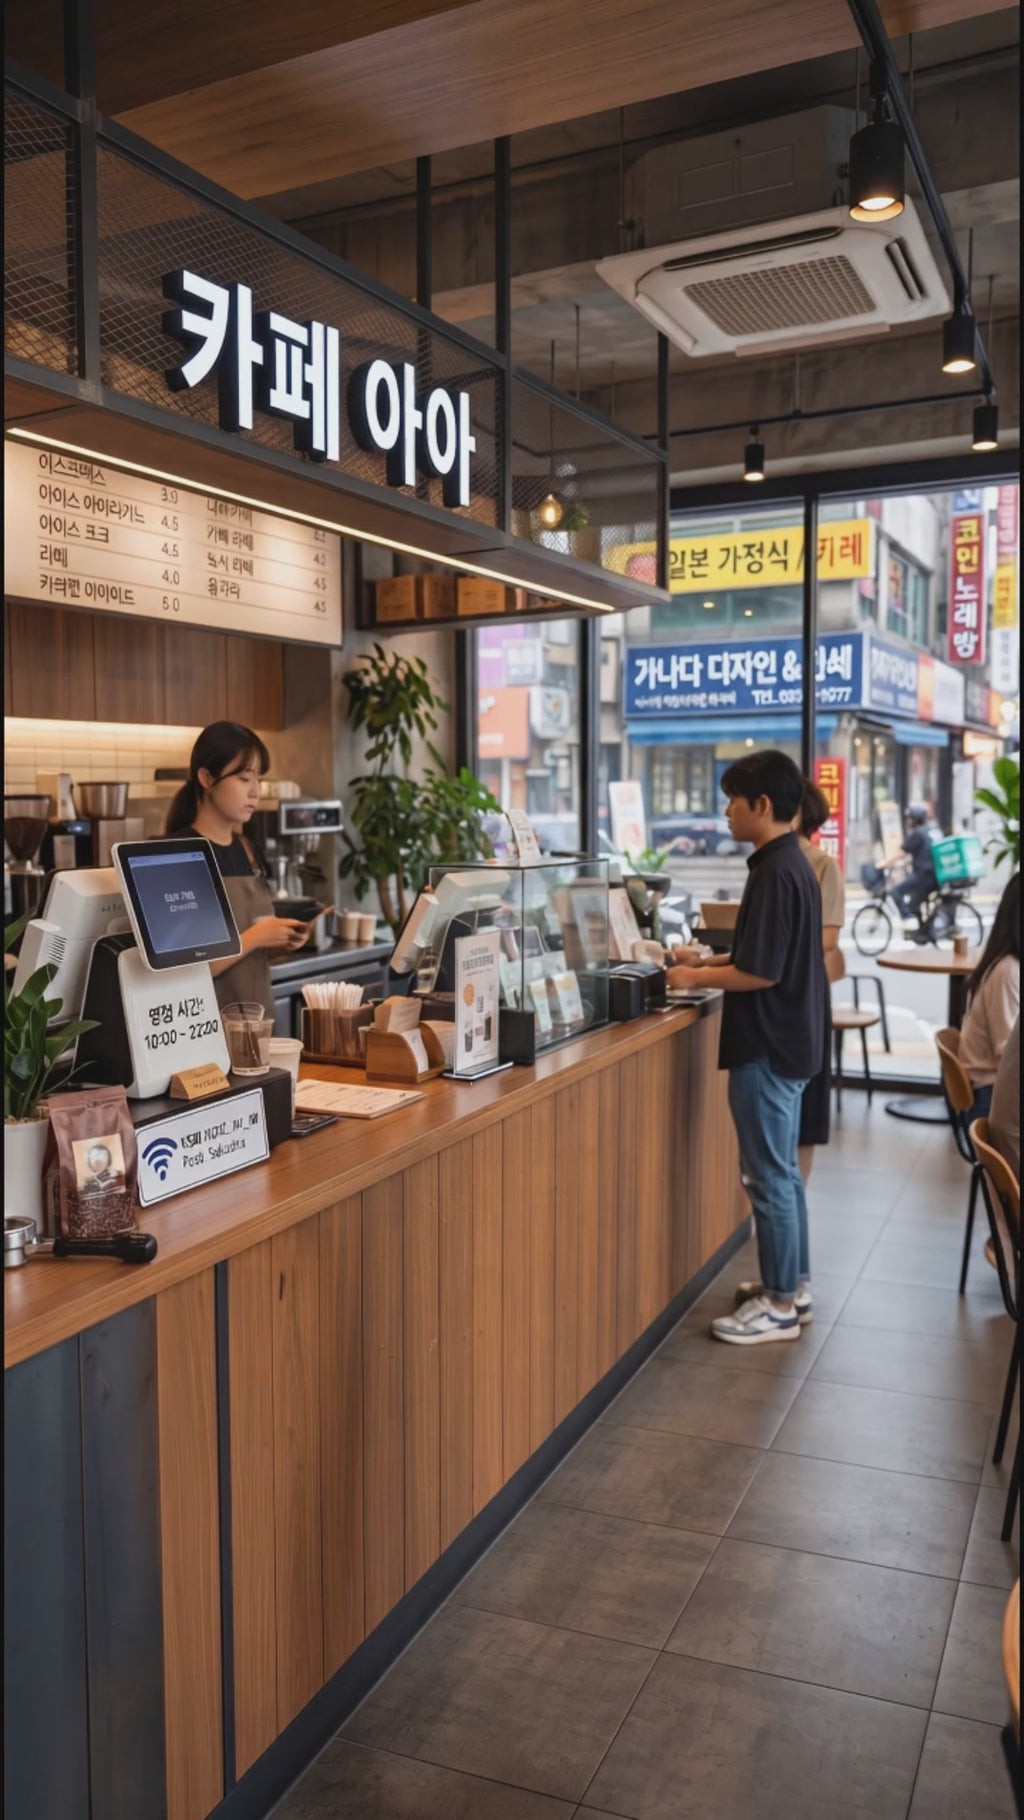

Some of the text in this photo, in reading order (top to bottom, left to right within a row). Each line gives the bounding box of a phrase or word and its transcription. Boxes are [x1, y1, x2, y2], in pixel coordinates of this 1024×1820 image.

[181, 269, 476, 507] 카페 아아
[161, 515, 179, 531] 4.5
[161, 542, 179, 557] 4.5
[718, 539, 789, 575] 가정식
[162, 569, 180, 585] 4.0
[634, 653, 704, 690] 가나다
[707, 649, 777, 686] 디자인
[782, 648, 803, 682] &
[145, 1029, 177, 1050] 10:00
